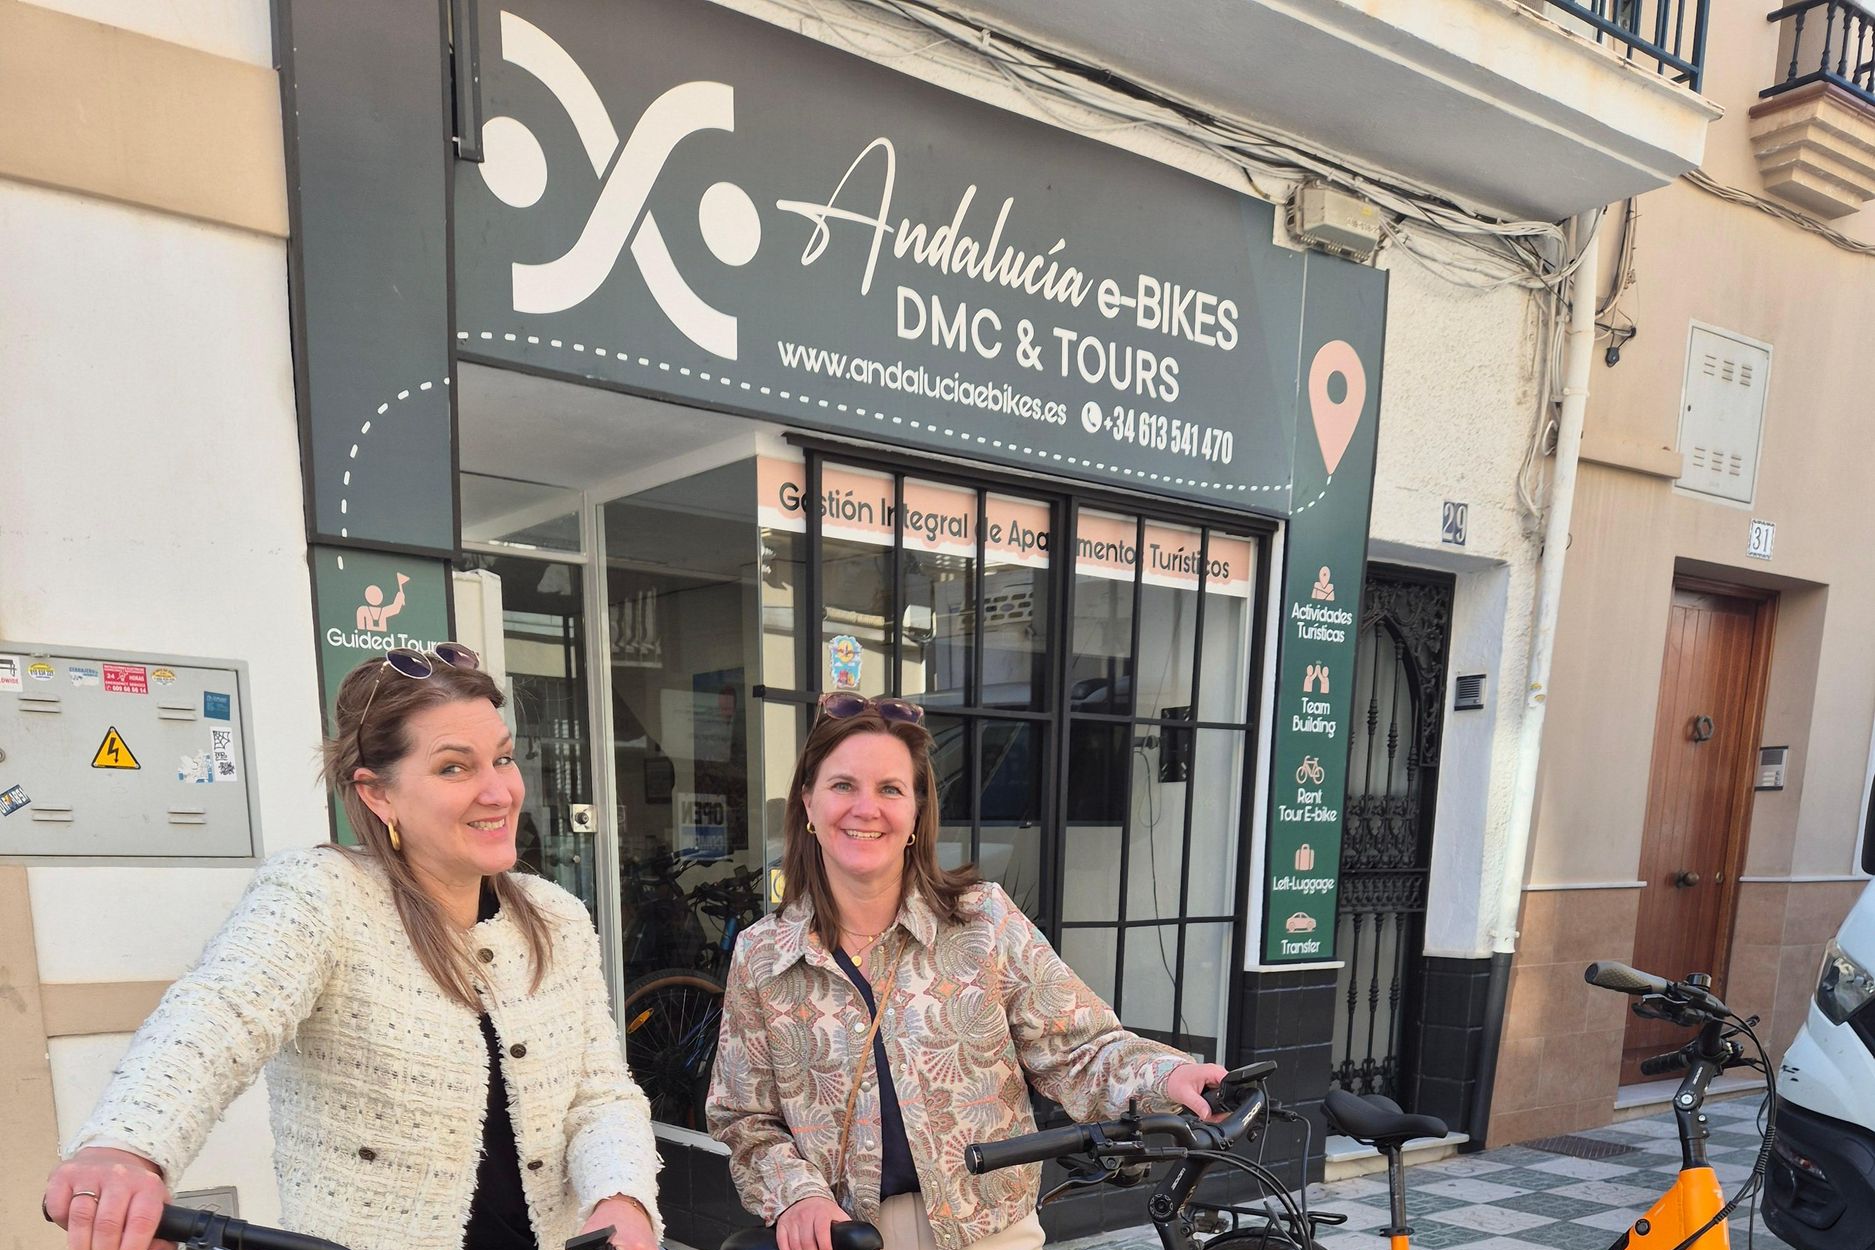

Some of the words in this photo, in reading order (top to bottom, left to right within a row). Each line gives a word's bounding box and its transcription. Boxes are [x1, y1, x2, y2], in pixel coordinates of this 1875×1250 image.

[776, 137, 1093, 308] Andalucía
[1098, 274, 1239, 351] e-BIKES
[897, 286, 1002, 359] DMC
[1016, 318, 1043, 372] &
[1054, 327, 1180, 402] TOURS
[777, 340, 1067, 426] www.andaluciaebikes.es
[1104, 406, 1135, 443] +34
[1139, 412, 1168, 450] 613
[1171, 419, 1199, 457] 541
[1201, 427, 1234, 464] 470
[1443, 503, 1467, 542] 29
[1753, 526, 1769, 552] 31
[1291, 602, 1352, 625] Actividades
[327, 628, 394, 651] Guided
[1297, 621, 1345, 643] Turísticas
[1301, 697, 1330, 715] Team
[1292, 715, 1336, 738] Building
[1297, 788, 1322, 804] Rent
[1278, 805, 1303, 822] Tour
[1305, 806, 1337, 822] E-bike
[1273, 876, 1335, 894] Left-Luggage
[1281, 939, 1320, 955] Transfer
